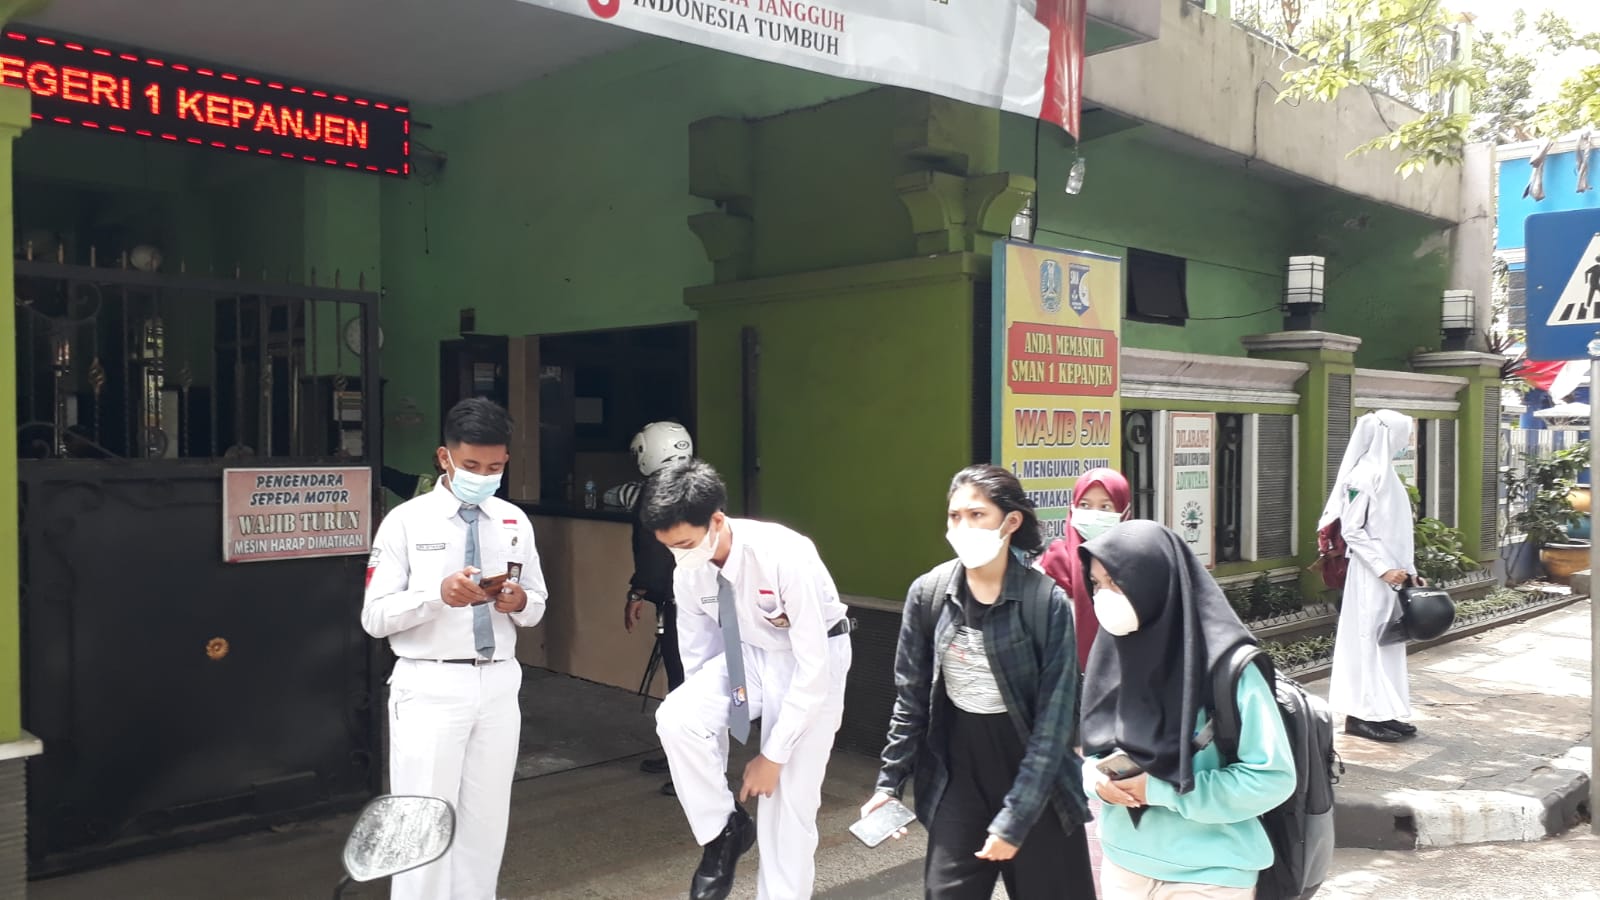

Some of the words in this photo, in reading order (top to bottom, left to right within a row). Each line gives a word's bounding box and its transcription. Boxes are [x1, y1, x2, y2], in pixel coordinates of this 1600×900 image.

[754, 17, 839, 57] TUMBUH
[143, 81, 161, 115] 1
[176, 86, 368, 150] KEPANJEN
[1024, 332, 1053, 354] ANDA
[1055, 334, 1105, 358] MEMASUKI
[1011, 359, 1045, 382] SMAN
[1047, 362, 1055, 383] 1
[1058, 362, 1112, 388] KEPANJEN
[1014, 408, 1077, 446] WAJIB
[1080, 410, 1112, 446] 5M
[256, 474, 343, 488] PENGENDARA
[1023, 460, 1080, 478] MENGUKUR
[250, 492, 300, 506] SEPEDA
[304, 490, 349, 503] MOTOR
[238, 513, 296, 536] WAJIB
[299, 511, 360, 532] TURUN
[234, 541, 268, 554] MESIN
[270, 539, 305, 552] HARAP
[307, 534, 363, 549] DIMATIKAN
